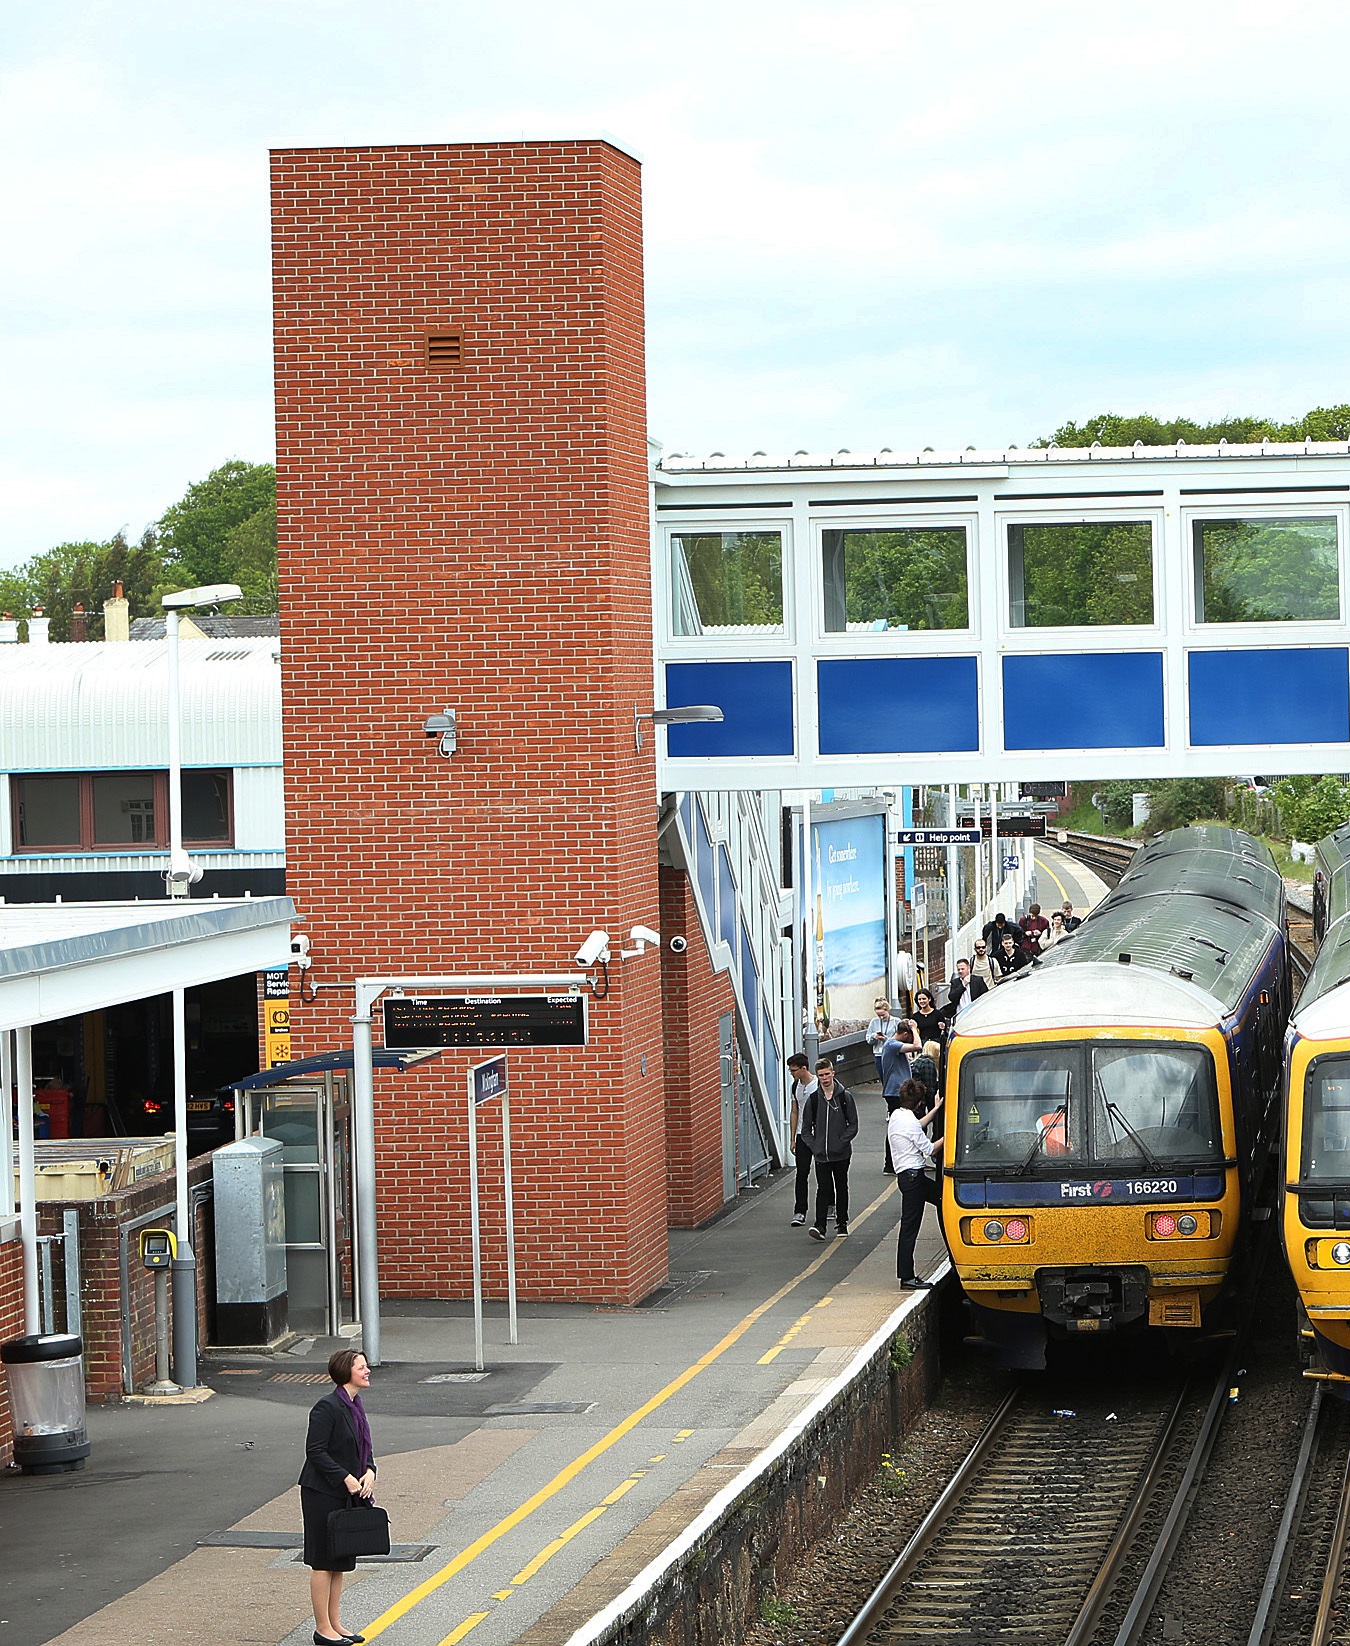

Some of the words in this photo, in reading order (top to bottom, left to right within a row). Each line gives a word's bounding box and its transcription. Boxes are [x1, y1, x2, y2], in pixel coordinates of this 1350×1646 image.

[929, 833, 948, 844] Help
[949, 833, 971, 844] point
[1002, 856, 1019, 867] 2-4
[266, 972, 284, 980] MOT
[266, 987, 290, 996] Repai
[464, 997, 502, 1006] Destination
[547, 996, 578, 1004] Expected
[1060, 1182, 1092, 1198] First
[1126, 1180, 1177, 1195] 166220
